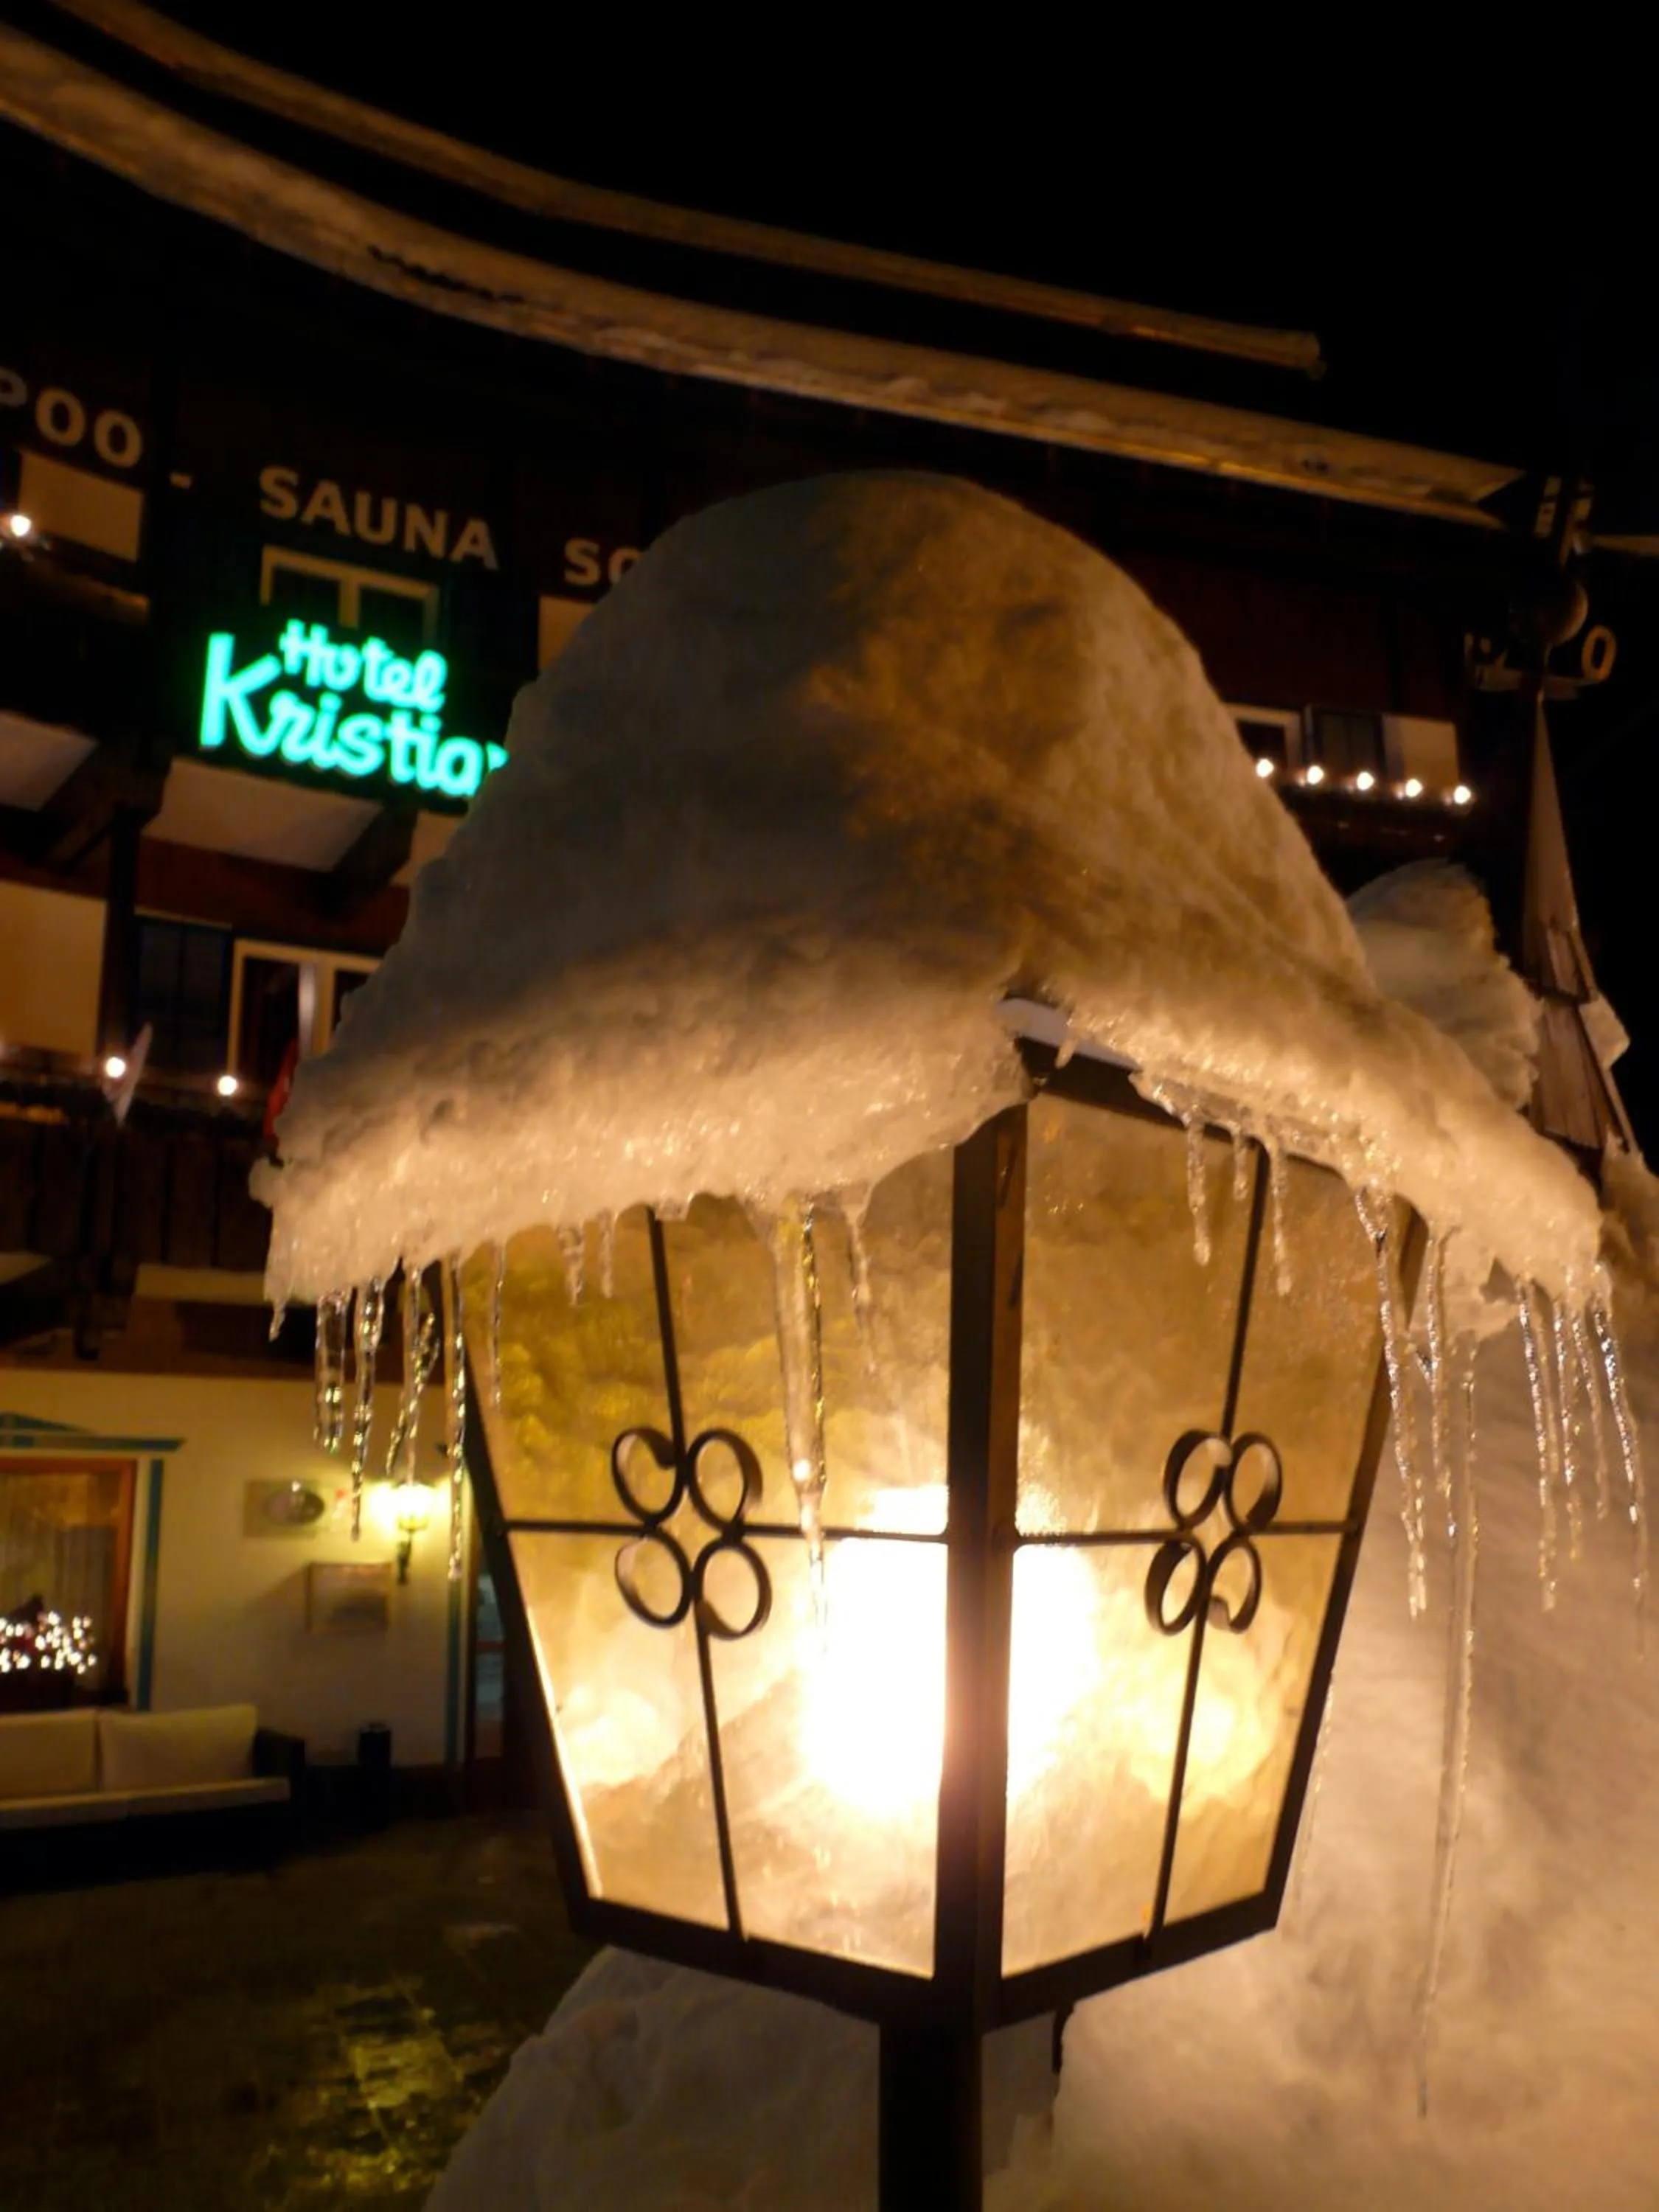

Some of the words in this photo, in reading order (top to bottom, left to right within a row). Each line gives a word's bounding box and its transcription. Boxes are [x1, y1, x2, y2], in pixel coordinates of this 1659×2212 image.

[259, 465, 499, 571] SAUNA
[198, 631, 509, 798] Kristia
[279, 618, 448, 711] Hotel
